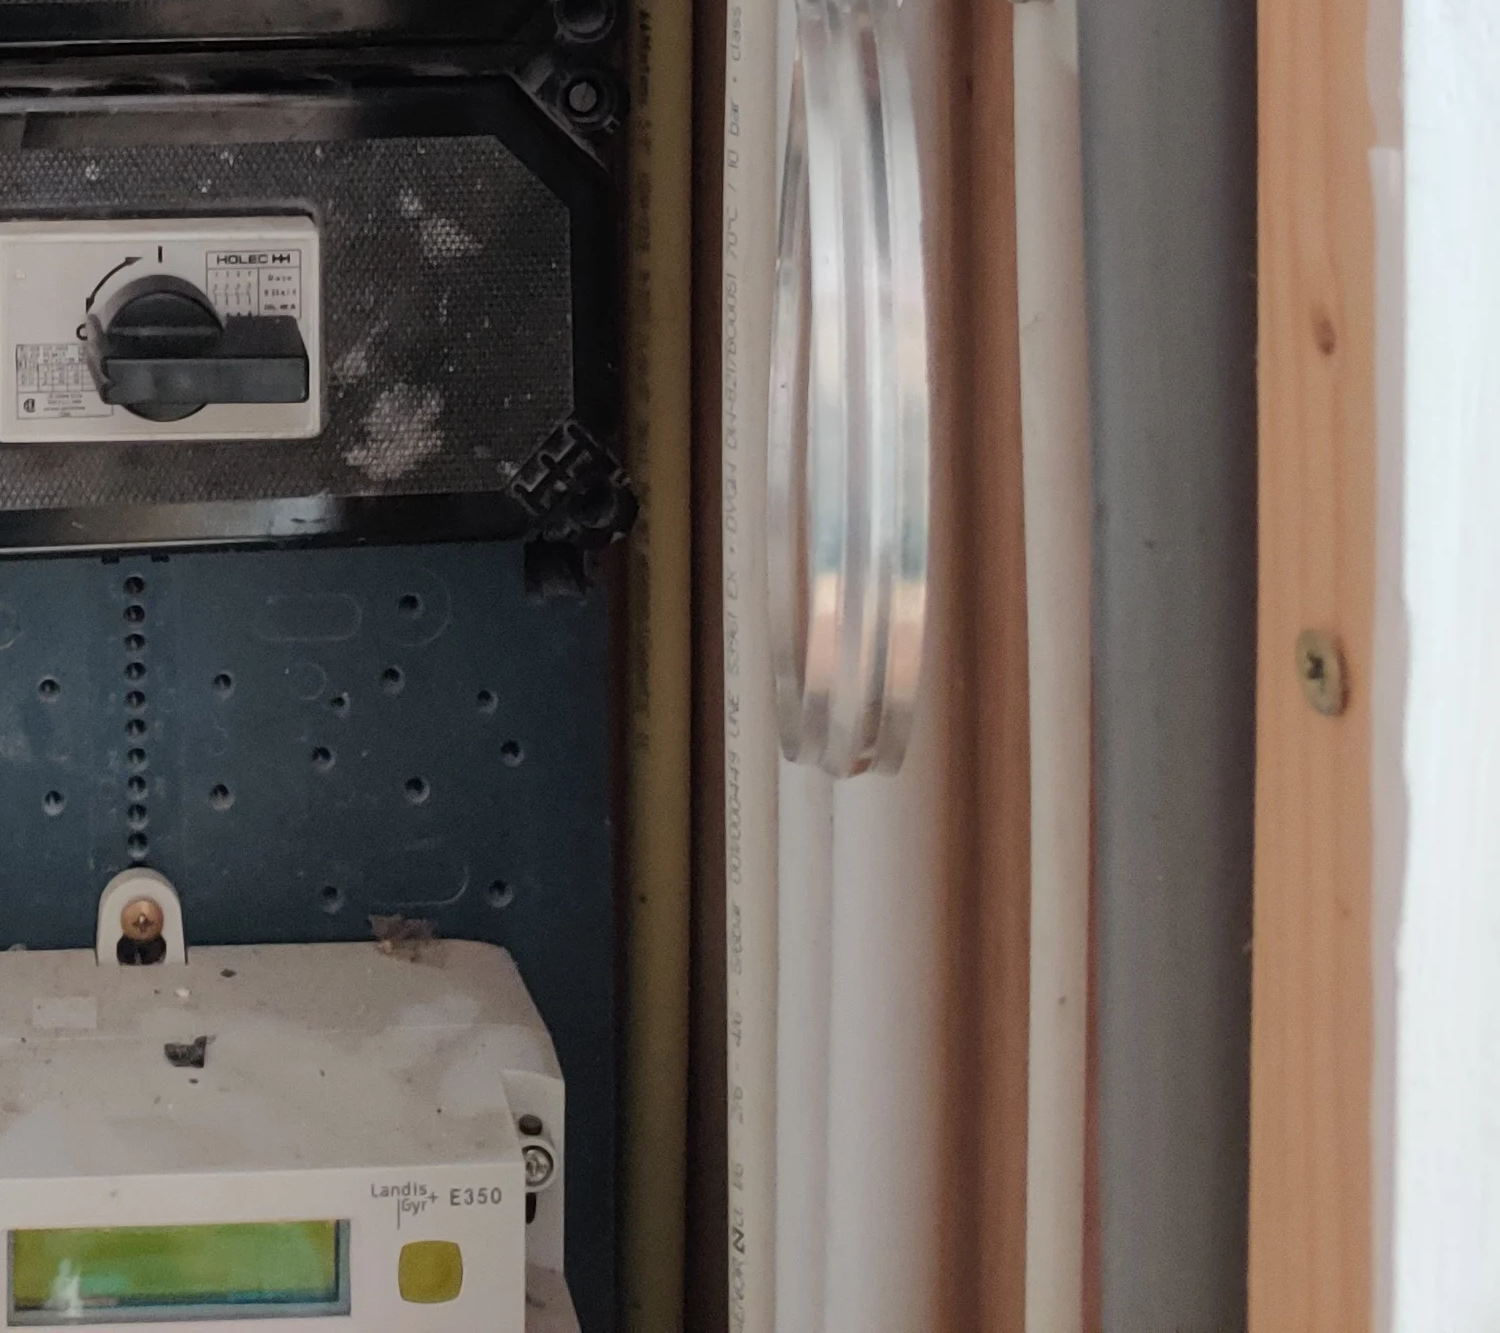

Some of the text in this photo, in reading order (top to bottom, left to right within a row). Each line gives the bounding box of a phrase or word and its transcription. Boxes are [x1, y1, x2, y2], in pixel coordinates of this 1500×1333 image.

[729, 5, 742, 62] class
[728, 98, 741, 137] bar
[216, 253, 269, 265] HOLEC
[371, 1181, 503, 1207] Landis E350
[401, 1198, 428, 1216] Gyr
